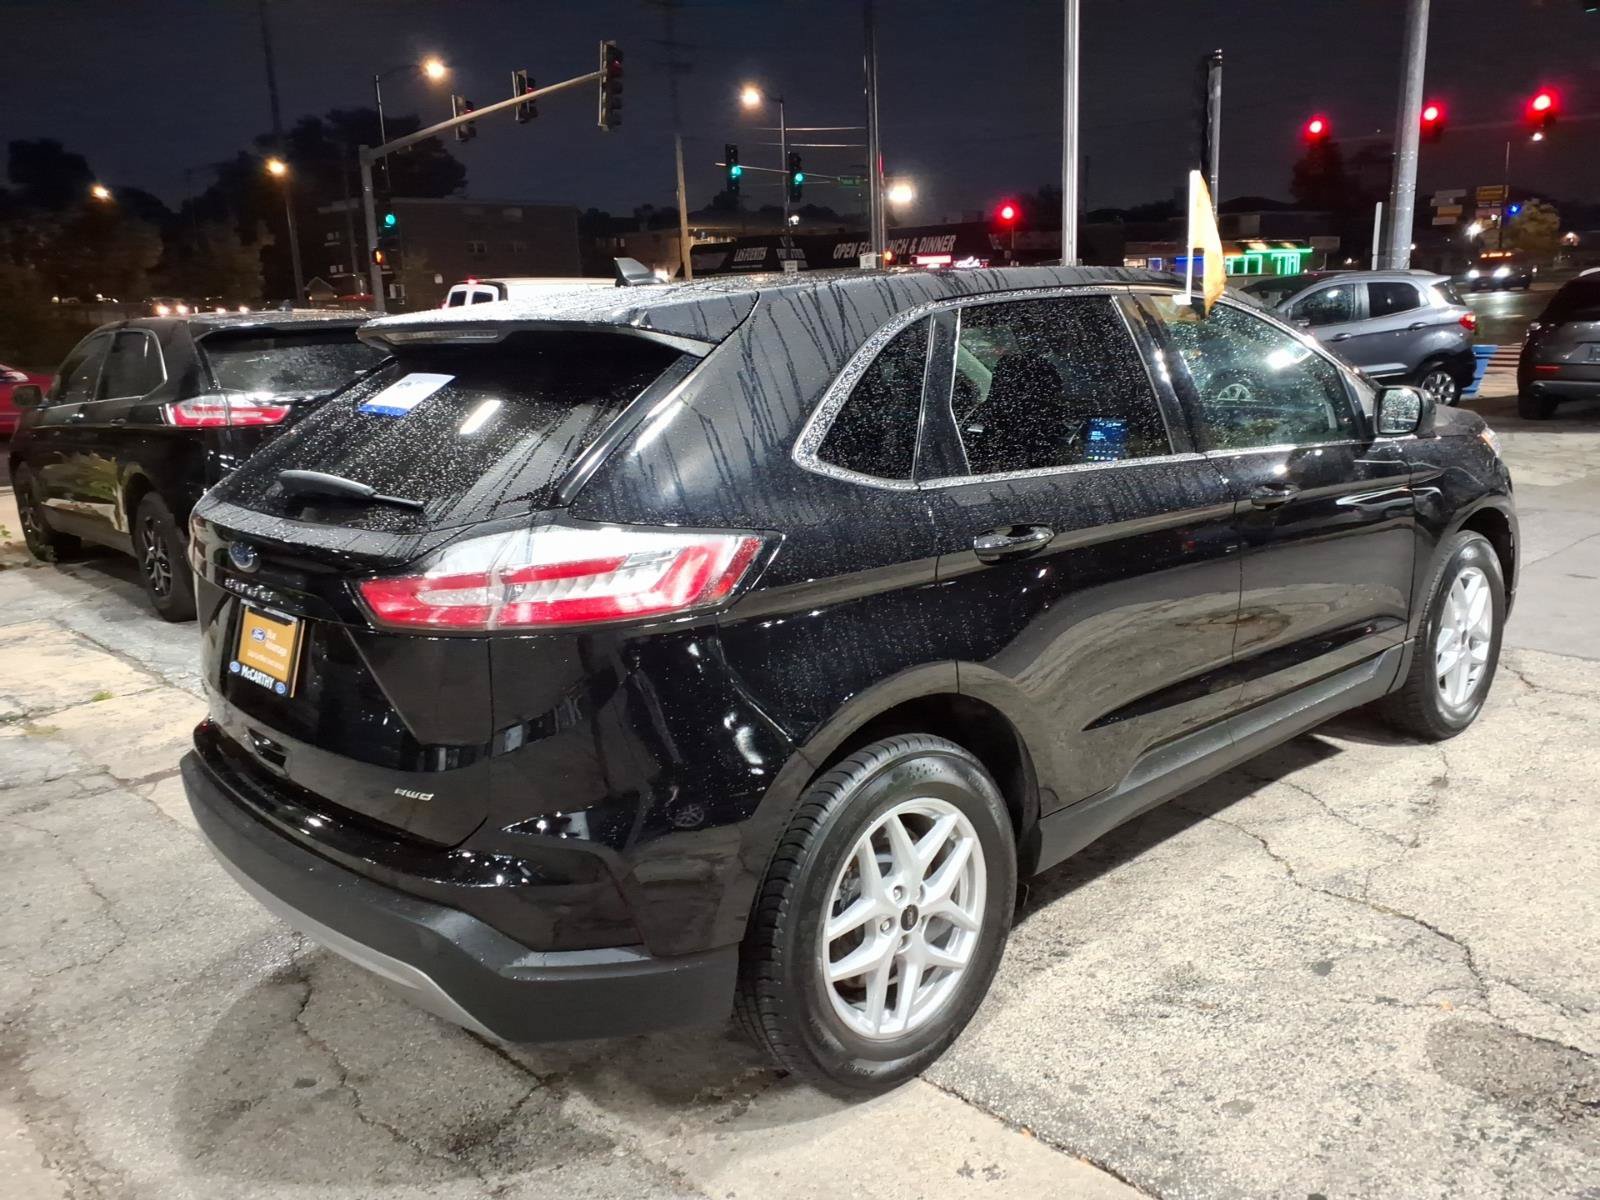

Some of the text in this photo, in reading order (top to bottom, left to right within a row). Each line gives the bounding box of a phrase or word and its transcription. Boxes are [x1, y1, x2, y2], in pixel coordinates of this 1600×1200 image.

[833, 241, 858, 259] OPEN
[909, 238, 918, 253] &
[919, 235, 957, 252] DINNER
[241, 665, 275, 689] McCARTHY
[394, 787, 435, 801] AWD
